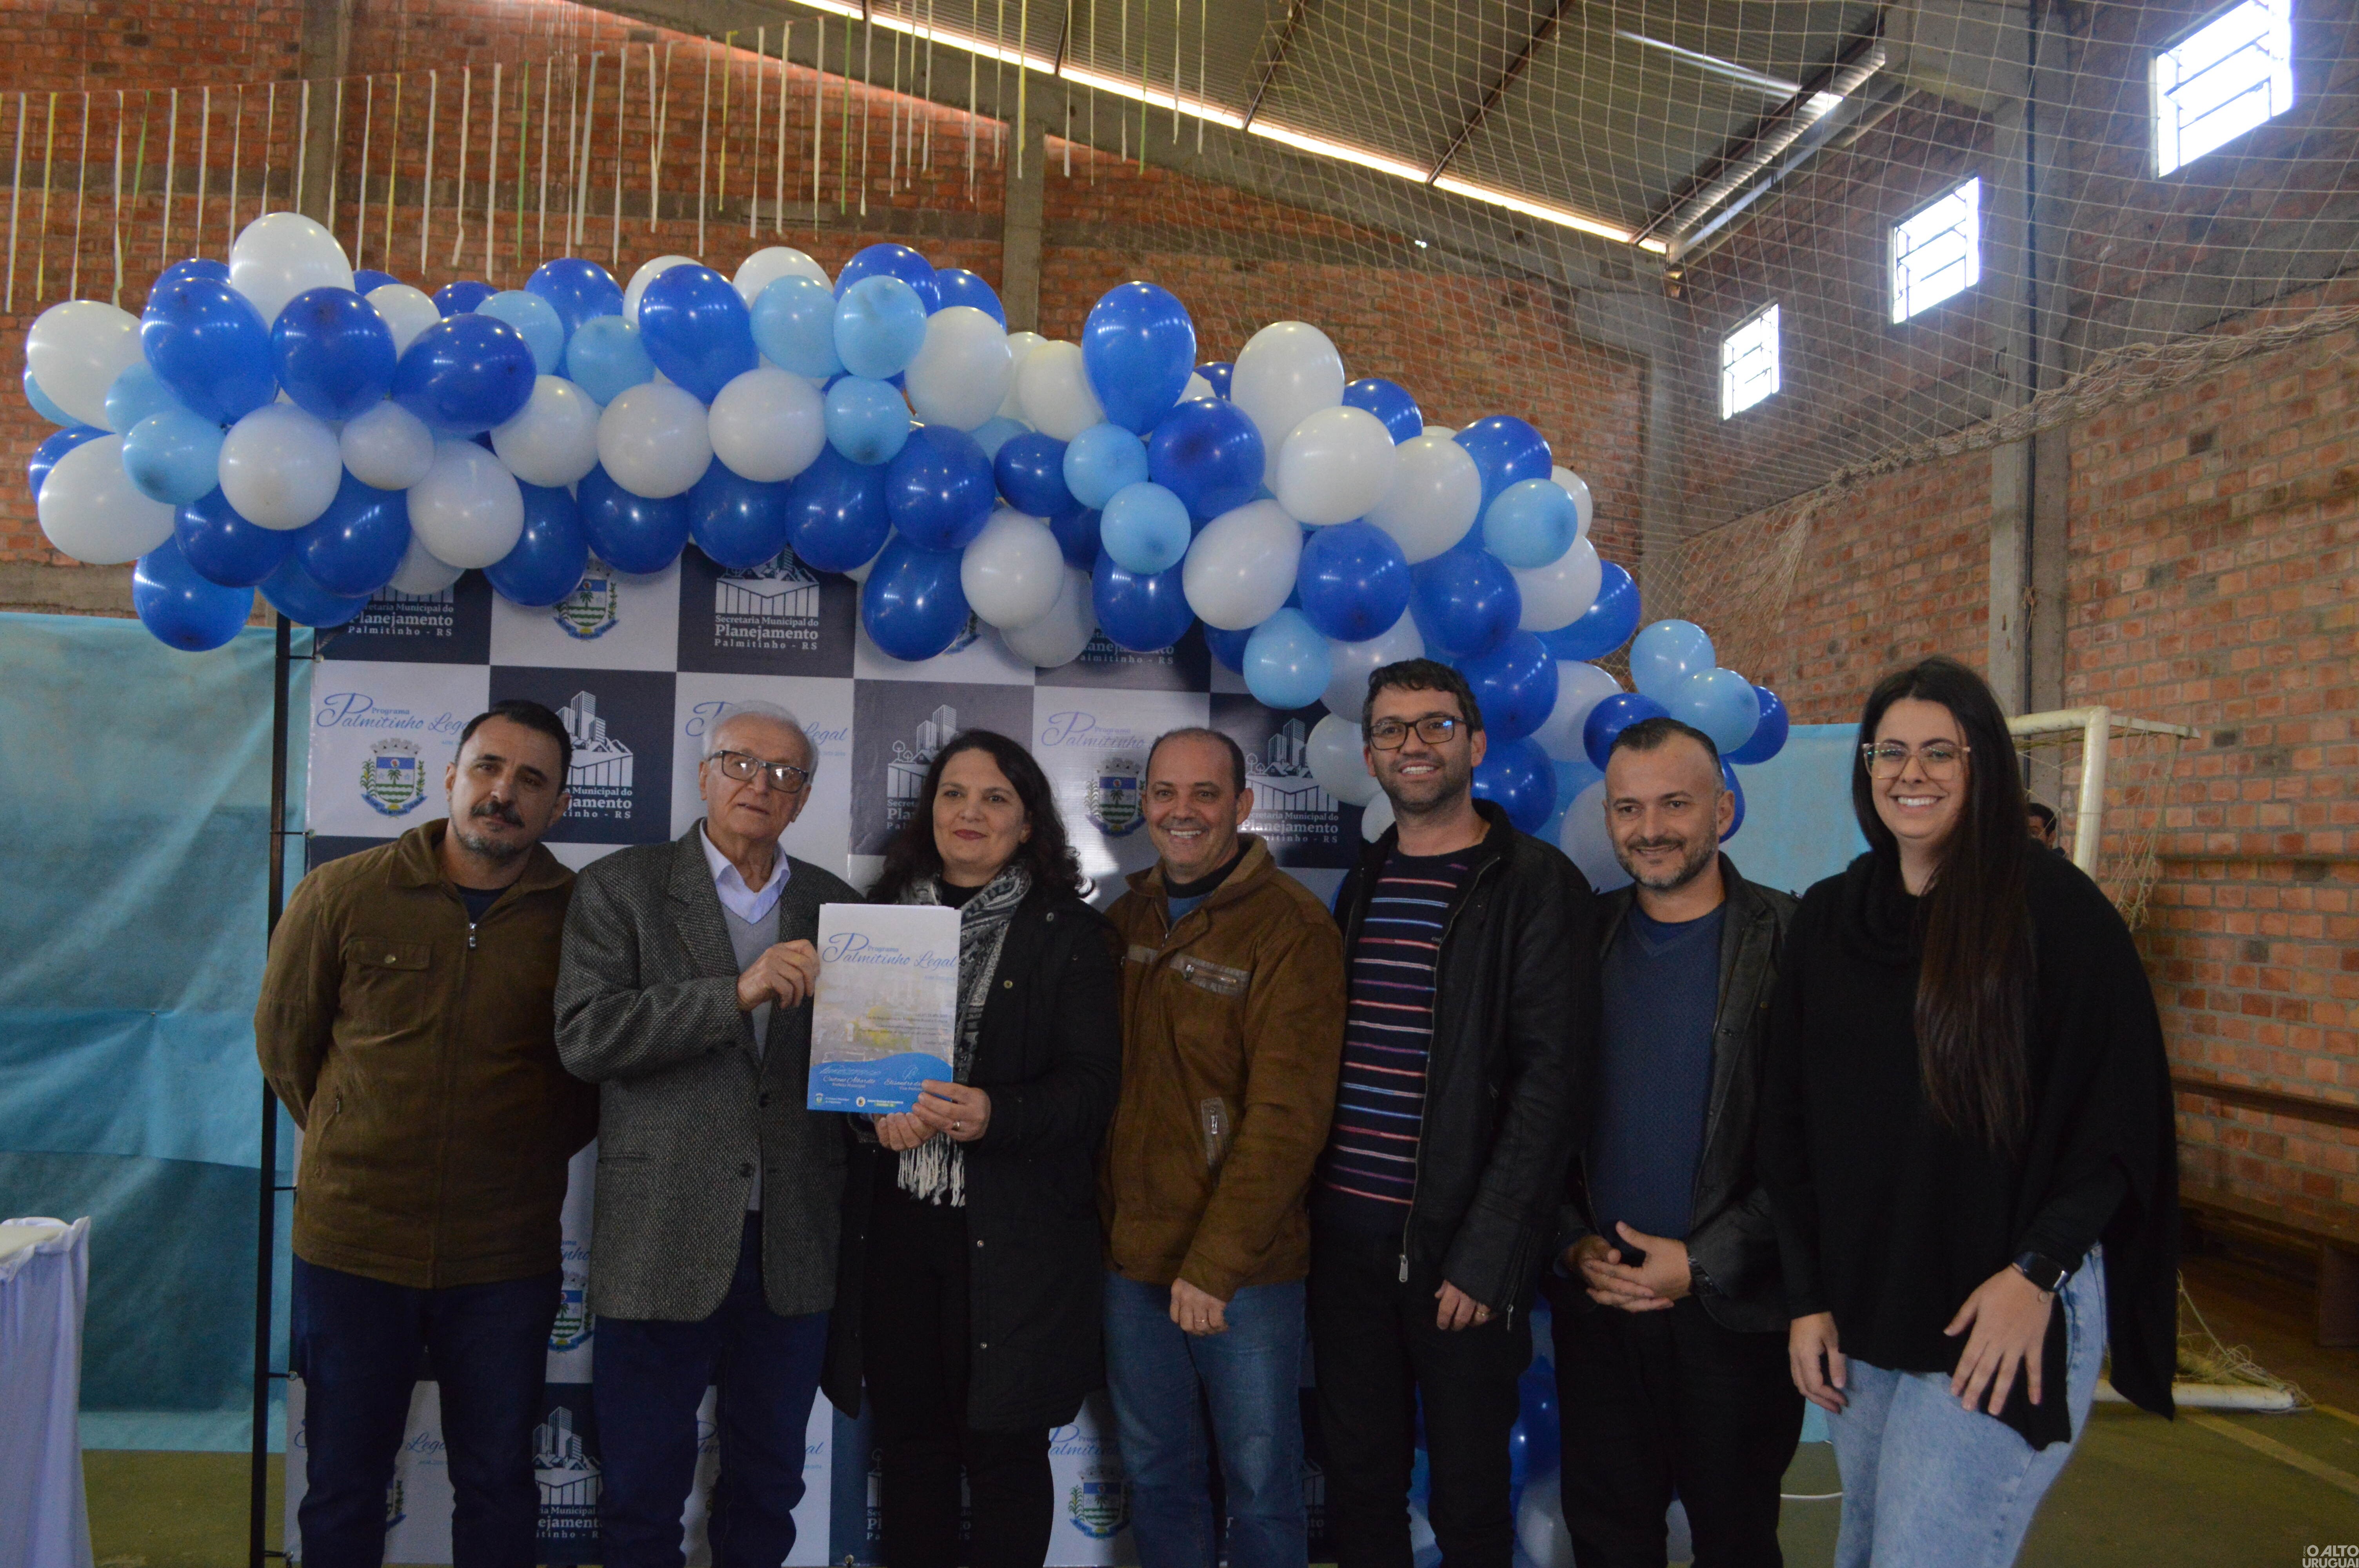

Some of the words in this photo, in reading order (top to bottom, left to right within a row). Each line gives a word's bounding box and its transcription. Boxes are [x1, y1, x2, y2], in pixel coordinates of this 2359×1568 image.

[396, 604, 441, 613] Municipal
[715, 615, 760, 624] Secretaria
[761, 617, 806, 627] Municipal
[348, 626, 420, 636] Palmitinho
[715, 624, 819, 641] Planejamento
[714, 639, 786, 649] Palmitinho
[802, 642, 817, 650] RS
[1080, 654, 1143, 663] almitinho
[1159, 656, 1174, 665] RS
[316, 693, 424, 730] Palmitinho
[1041, 711, 1145, 748] Palmitinho
[572, 787, 619, 797] Municipal
[567, 795, 632, 809] jamento
[614, 810, 631, 818] RS
[1285, 812, 1327, 822] Municipal
[1241, 819, 1338, 835] Planejamento
[822, 933, 911, 965] Palmitinho
[914, 951, 957, 971] Legal
[550, 1506, 596, 1516] Municipal
[536, 1529, 576, 1538] itinho
